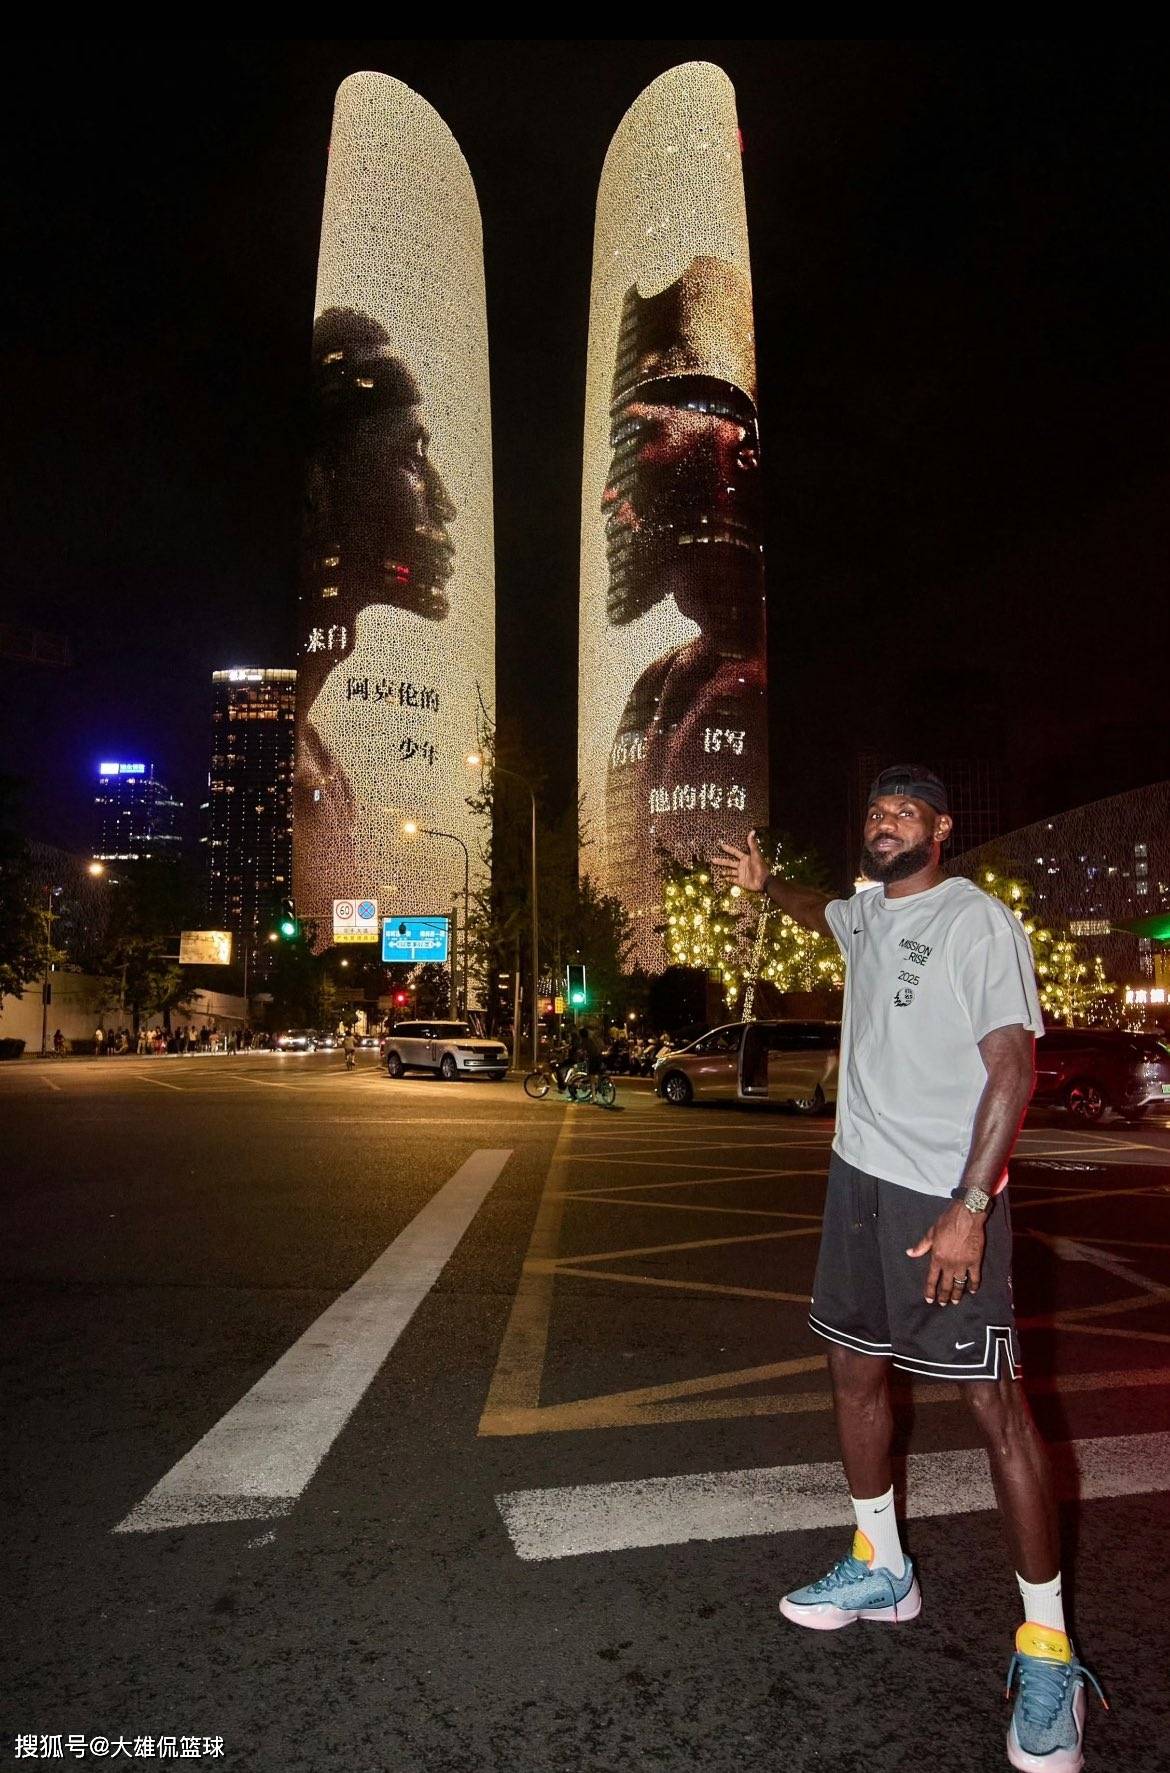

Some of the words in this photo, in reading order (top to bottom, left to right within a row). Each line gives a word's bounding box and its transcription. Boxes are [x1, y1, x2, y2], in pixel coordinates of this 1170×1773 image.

[307, 625, 347, 652] 来自
[346, 678, 439, 712] 阿克伦的
[400, 738, 438, 765] 少年
[649, 783, 746, 814] 他的传奇
[339, 905, 350, 916] 60
[899, 938, 933, 957] MISSION
[908, 951, 929, 967] RISE
[897, 970, 920, 986] 2025
